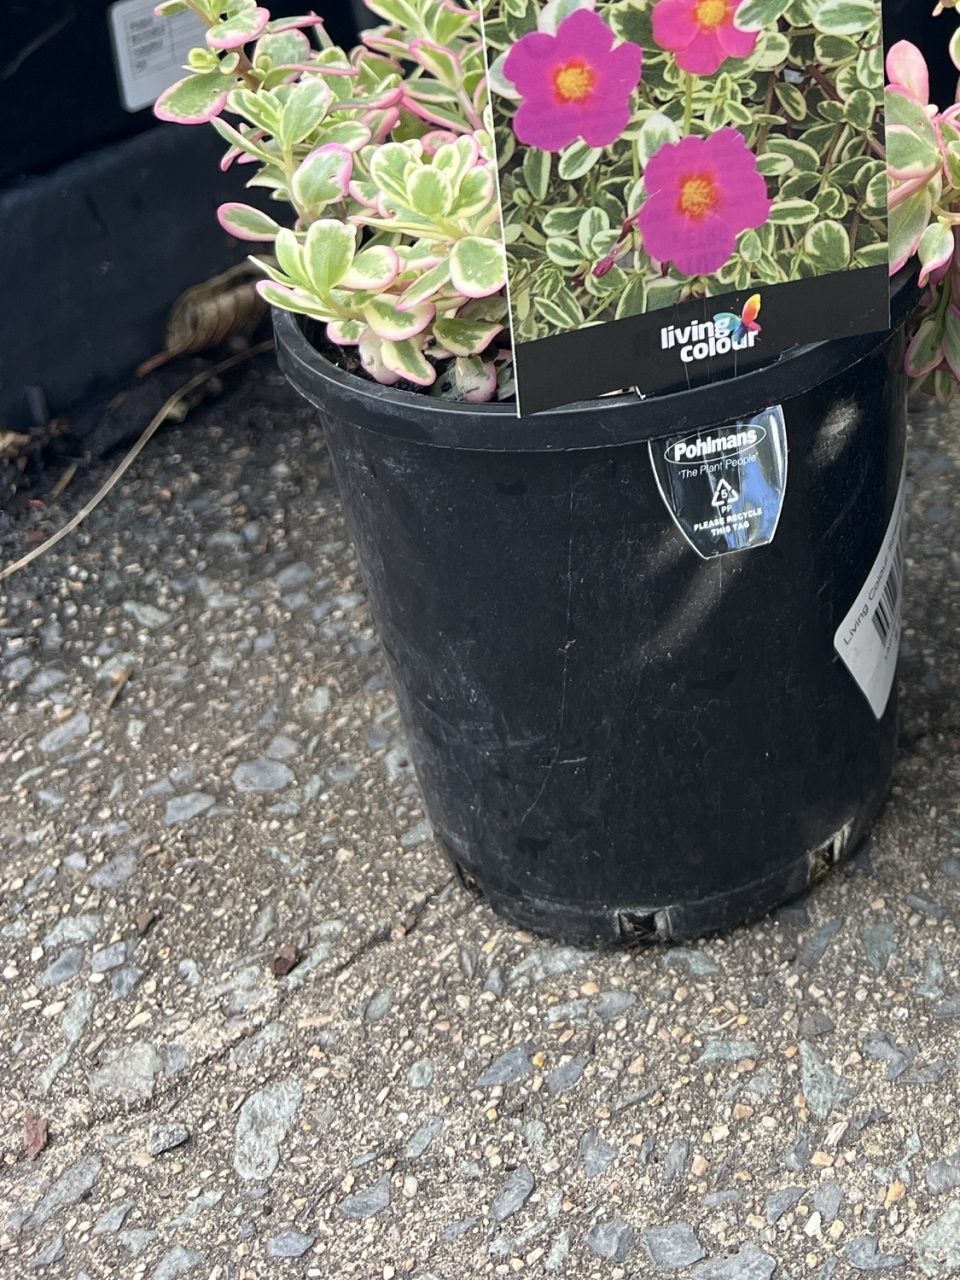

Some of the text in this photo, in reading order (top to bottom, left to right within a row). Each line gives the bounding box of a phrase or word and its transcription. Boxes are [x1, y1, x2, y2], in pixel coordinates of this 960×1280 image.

[660, 318, 731, 350] living
[680, 330, 759, 363] colour
[674, 429, 758, 462] Pohlmans
[700, 462, 723, 475] Plant
[720, 488, 728, 499] 5
[693, 507, 763, 532] PLEASE RECYCLE
[721, 505, 732, 514] PP
[711, 521, 750, 536] THIS TAG
[843, 604, 869, 646] Living
